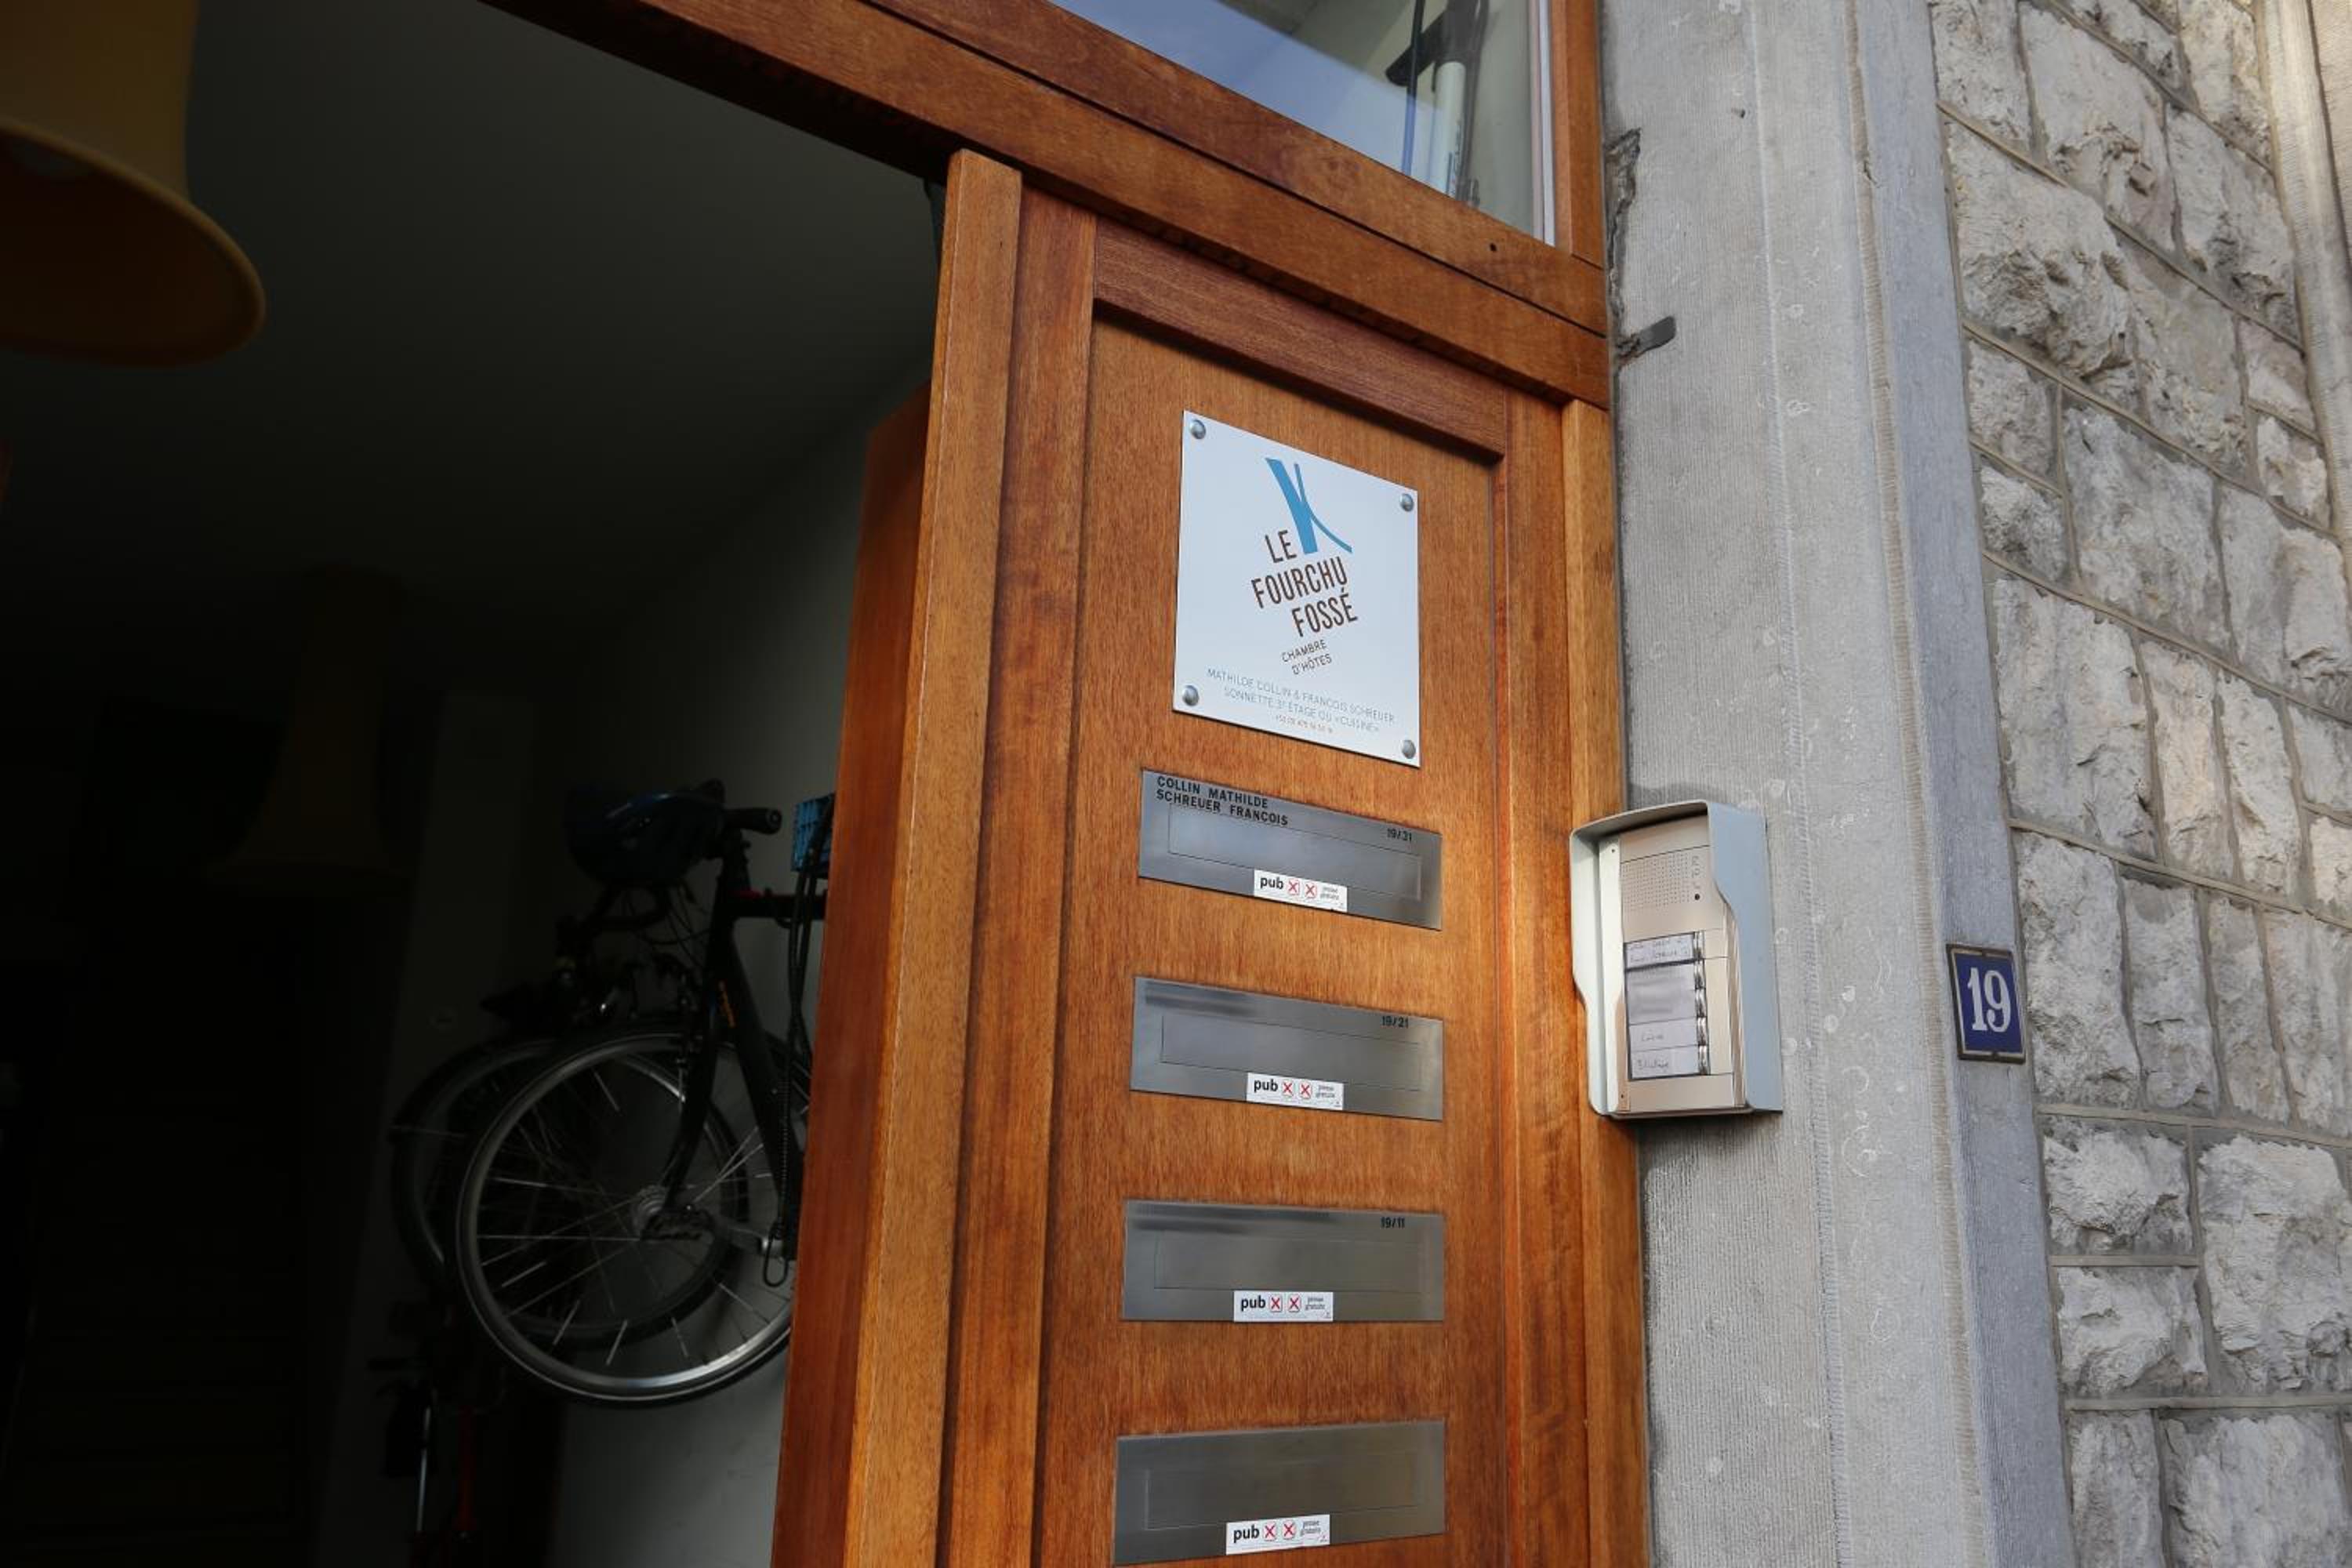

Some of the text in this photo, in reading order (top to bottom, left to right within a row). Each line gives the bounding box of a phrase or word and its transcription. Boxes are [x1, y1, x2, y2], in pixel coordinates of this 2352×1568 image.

[1265, 529, 1298, 564] LE
[1250, 556, 1348, 609] FOURCHU
[1291, 586, 1359, 637] FOSSÉ
[1282, 639, 1327, 662] CHAMBRE
[1207, 668, 1254, 688] MATHILDE
[1257, 681, 1291, 697] COLLIN
[1224, 686, 1273, 708] SONNETTE
[1156, 775, 1269, 808] COLLIN MATHILDE
[1156, 789, 1221, 813] SCHREUER
[1386, 828, 1414, 842] 19/31
[1260, 876, 1284, 890] pub
[1967, 967, 2012, 1033] 19
[1382, 1015, 1410, 1029] 19/21
[1254, 1078, 1279, 1093] pub
[1381, 1216, 1406, 1229] 19/11
[1241, 1294, 1266, 1312] pub
[1233, 1524, 1261, 1544] pub
